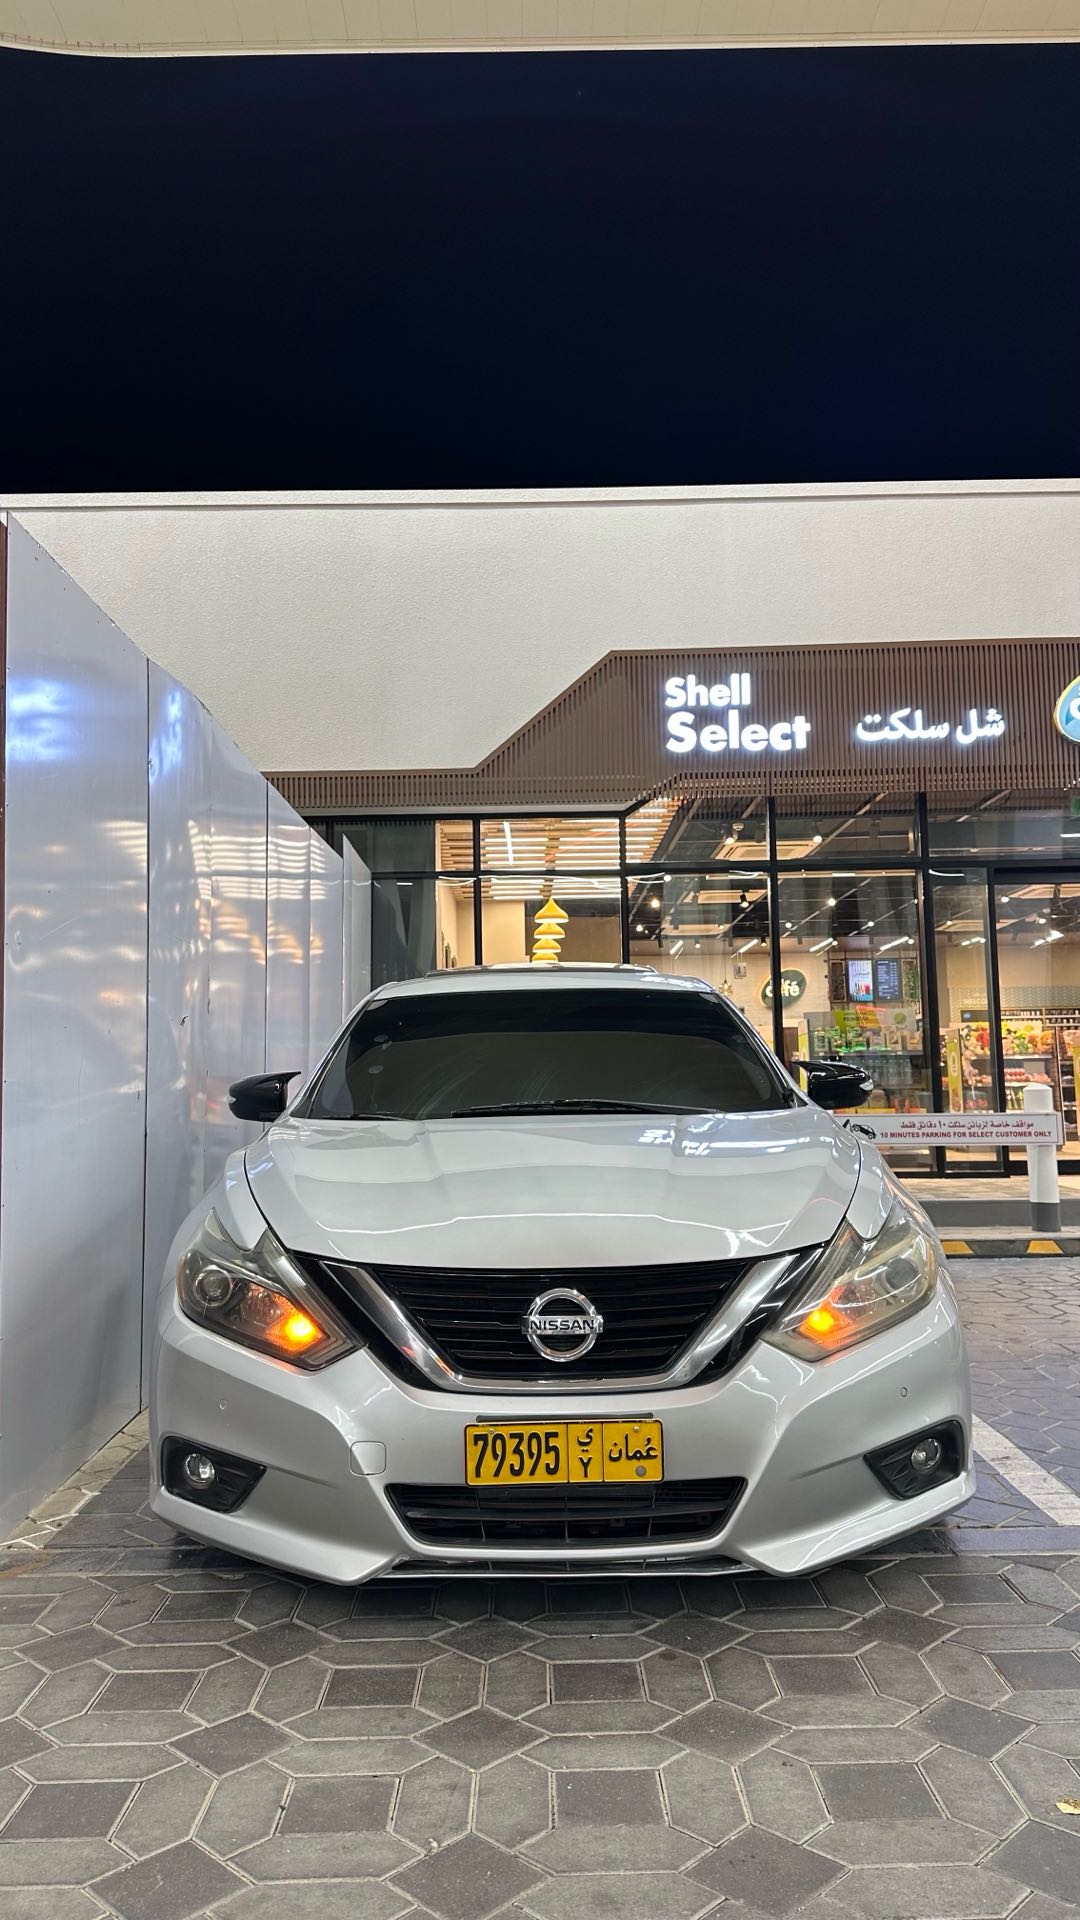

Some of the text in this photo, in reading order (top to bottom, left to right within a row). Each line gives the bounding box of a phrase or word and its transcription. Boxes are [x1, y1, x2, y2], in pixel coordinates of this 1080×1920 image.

[664, 673, 751, 706] Shell
[665, 709, 811, 752] Select
[856, 707, 1005, 744] شل سلكت
[901, 1121, 916, 1129] فقط
[990, 1120, 1010, 1128] خاصة
[1011, 1120, 1034, 1129] مواقف
[968, 1130, 994, 1138] SELECT
[995, 1130, 1032, 1138] CUSTOMER
[530, 1319, 595, 1331] NISSAN
[473, 1431, 560, 1478] 79395
[579, 1456, 593, 1478] Y
